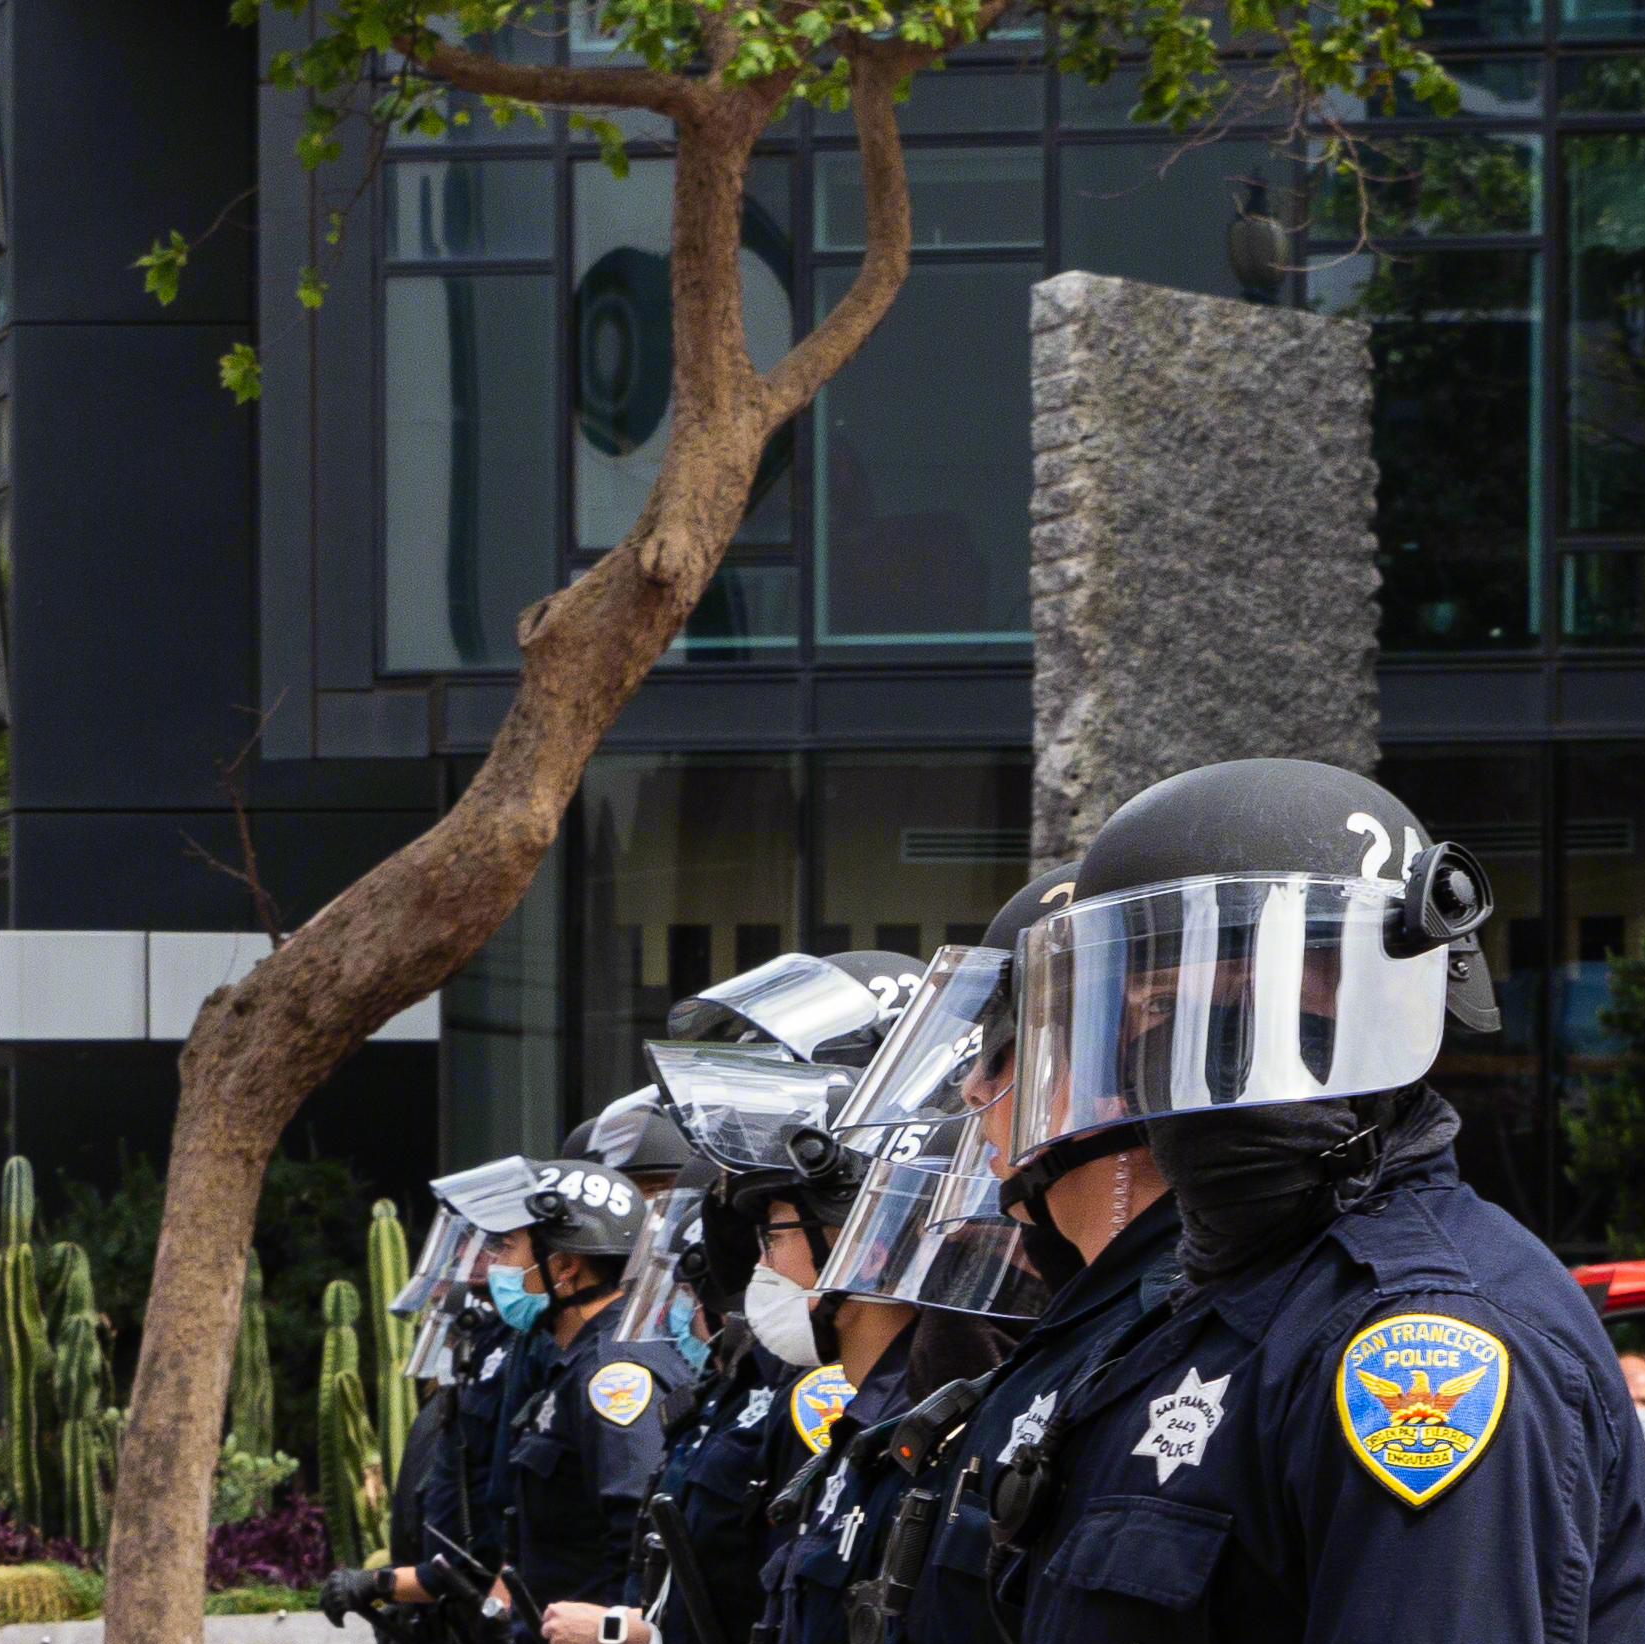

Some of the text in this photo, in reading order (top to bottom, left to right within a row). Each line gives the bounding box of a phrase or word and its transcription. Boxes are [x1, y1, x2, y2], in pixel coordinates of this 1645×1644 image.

[536, 1167, 633, 1217] 2495
[1350, 1323, 1498, 1367] SAN FRANCISCO
[1384, 1349, 1461, 1368] POLICE
[1155, 1399, 1176, 1418] SAN
[1152, 1434, 1196, 1457] POLICE
